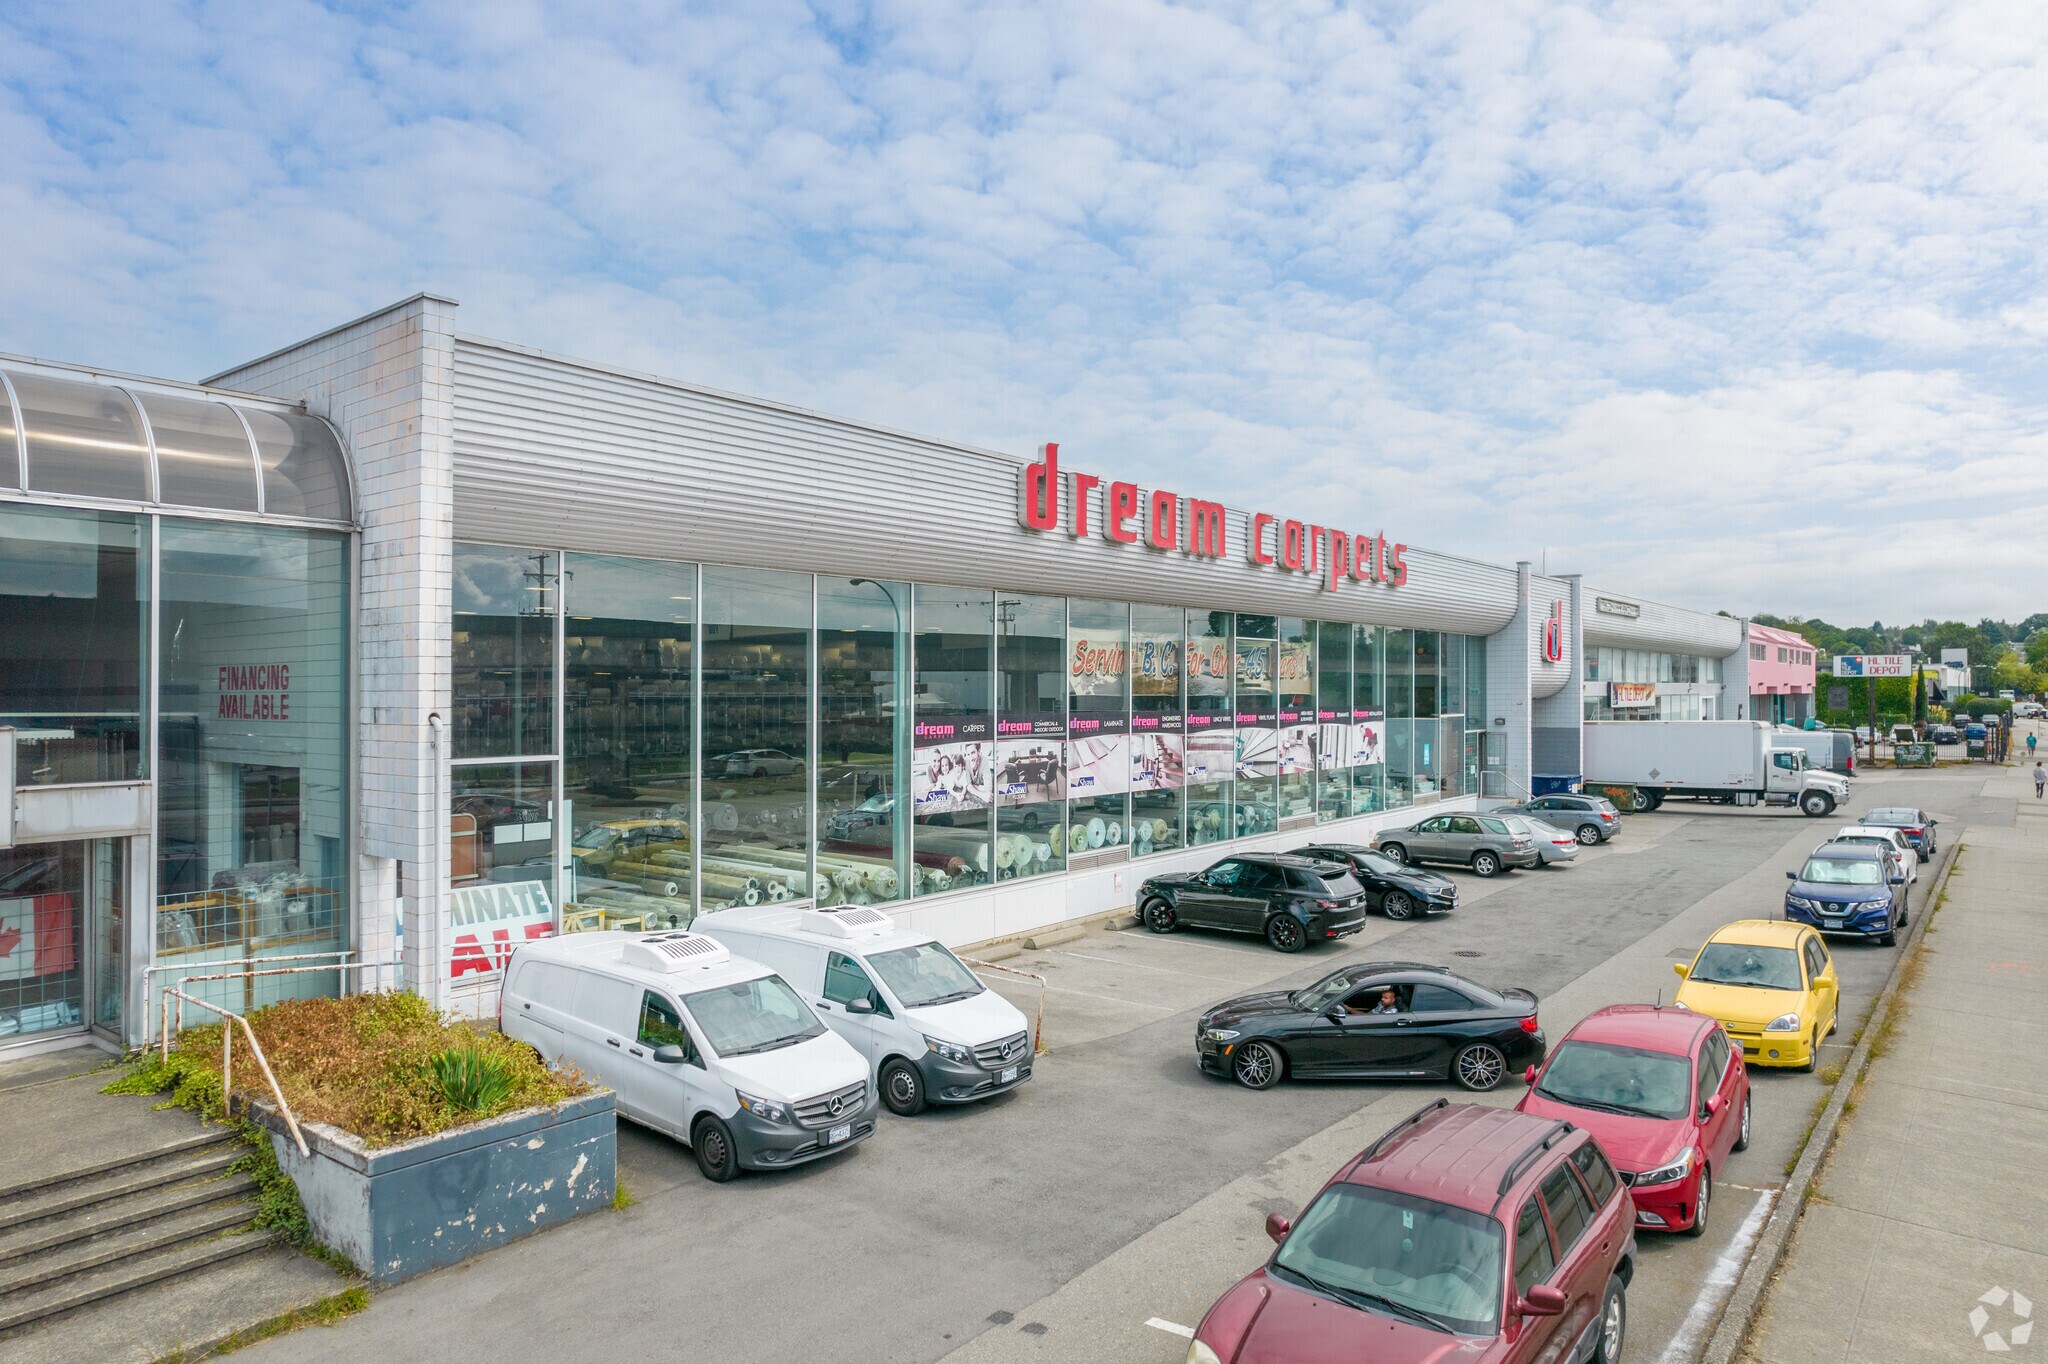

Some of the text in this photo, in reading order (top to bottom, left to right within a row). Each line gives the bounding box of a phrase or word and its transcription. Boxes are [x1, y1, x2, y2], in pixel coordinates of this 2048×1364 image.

[1020, 443, 1408, 592] dream carpets
[1071, 640, 1134, 677] Servin
[1246, 647, 1267, 679] 45
[1868, 656, 1904, 665] HL TILE
[1869, 666, 1902, 675] DEPOT
[218, 664, 289, 691] FINANCING
[218, 694, 289, 720] AVAILABLE
[1187, 713, 1211, 724] dream
[1236, 712, 1257, 722] dream
[1280, 710, 1298, 721] dream
[1319, 709, 1336, 719] dream
[997, 719, 1032, 732] dream
[1069, 717, 1099, 729] dream
[1132, 715, 1158, 726] dream
[915, 721, 985, 735] dream CARPETS
[1009, 785, 1026, 794] Shaw
[928, 792, 948, 803] Shaw
[450, 883, 549, 927] INATE
